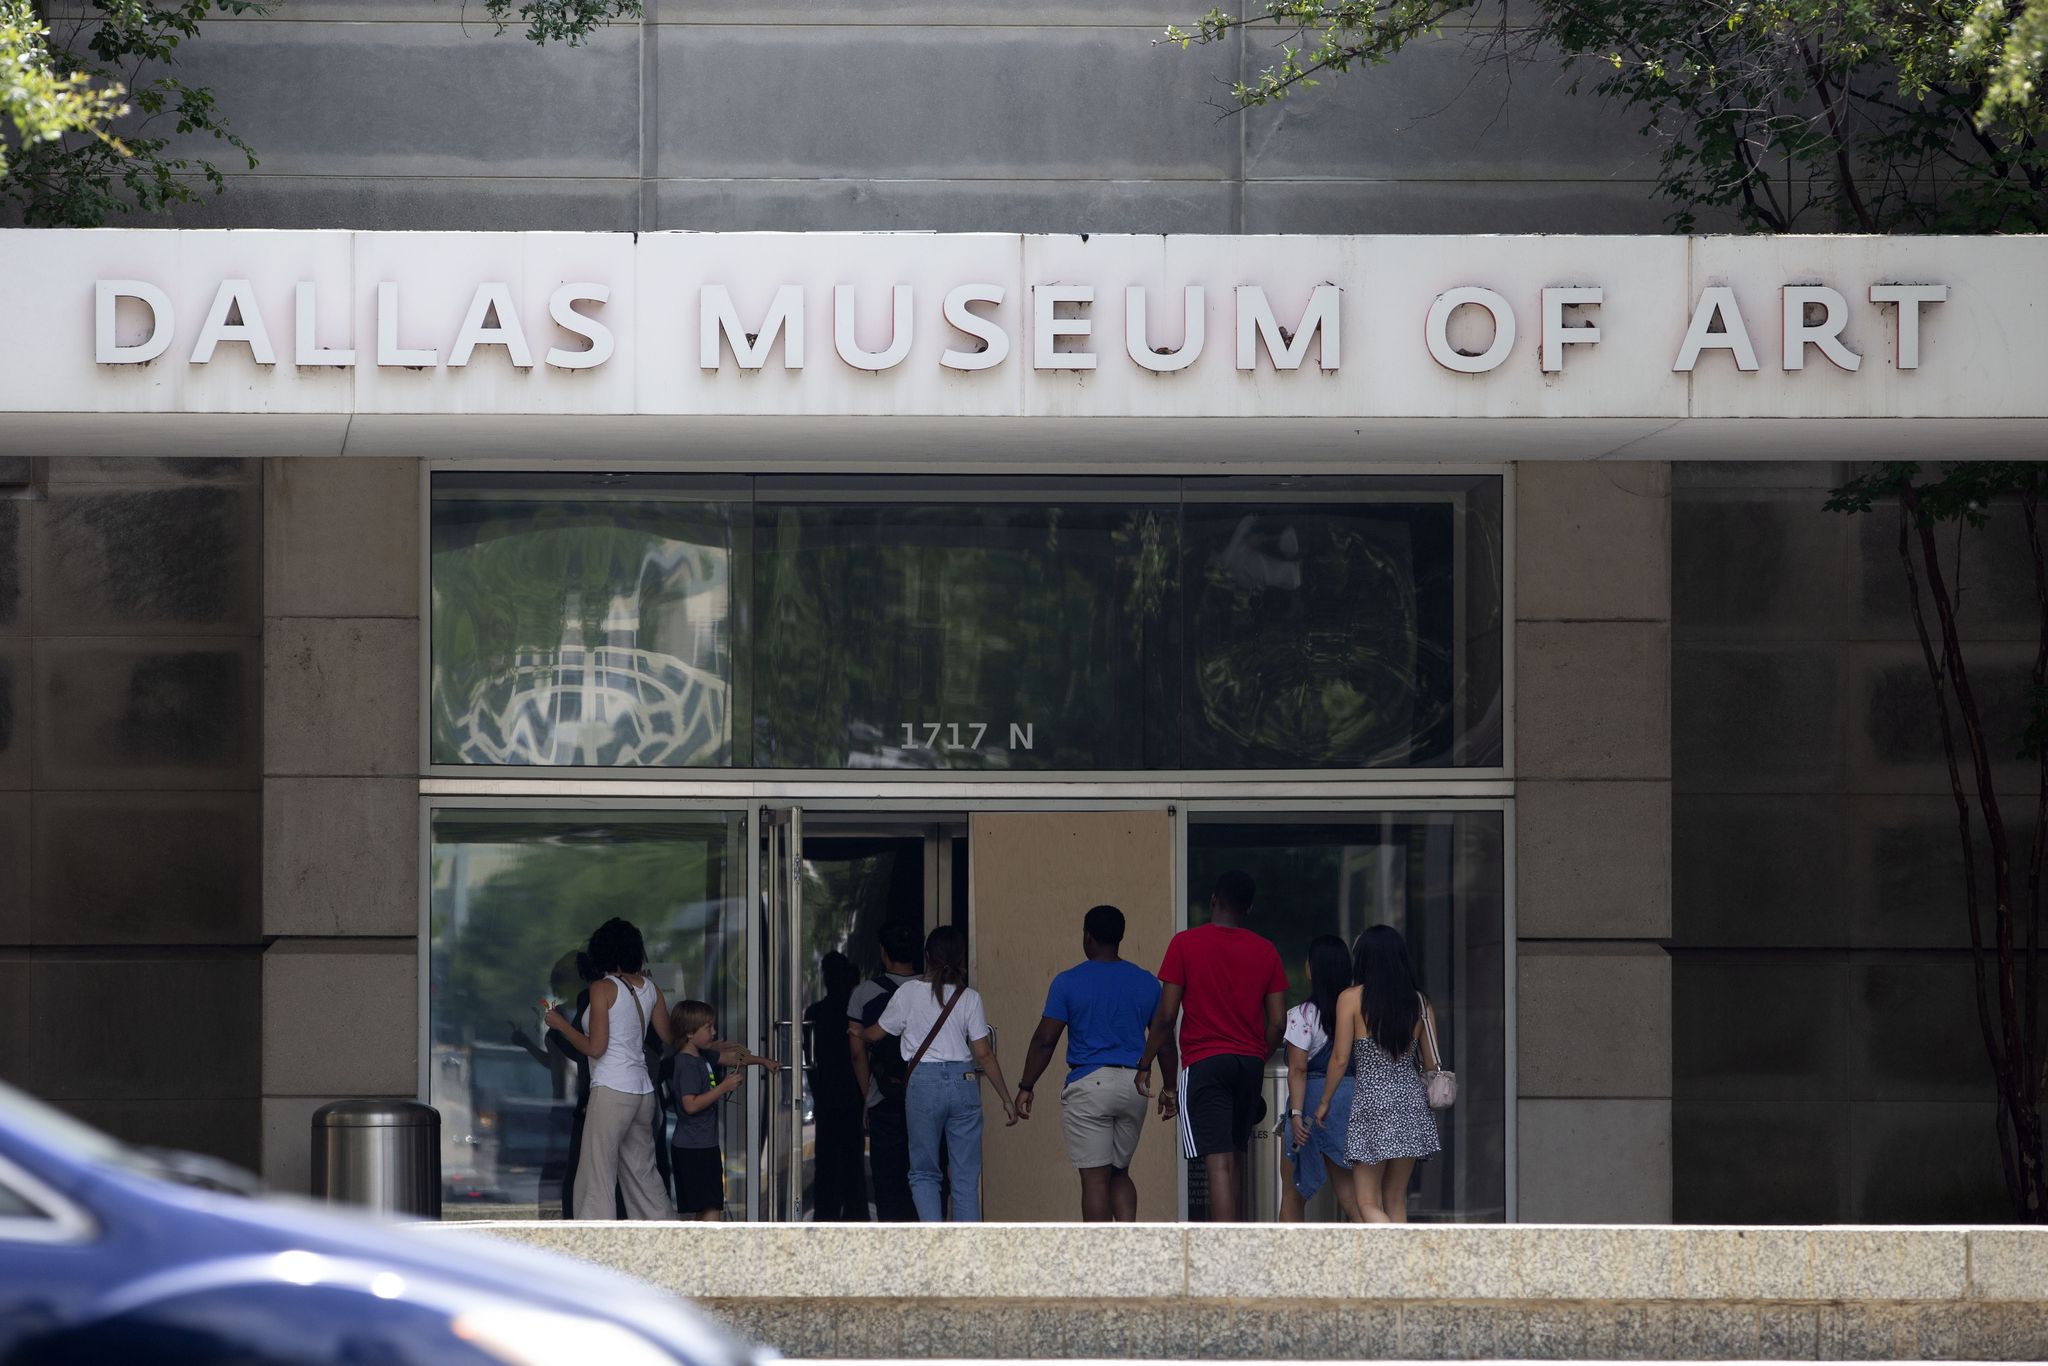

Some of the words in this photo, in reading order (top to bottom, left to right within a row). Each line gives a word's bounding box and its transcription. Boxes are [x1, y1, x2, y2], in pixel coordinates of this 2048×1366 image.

[95, 279, 615, 369] DALLAS
[700, 282, 1341, 372] MUSEUM
[1424, 285, 1604, 374] OF
[1671, 284, 1948, 373] ART
[901, 722, 988, 750] 1717
[1009, 722, 1033, 750] N
